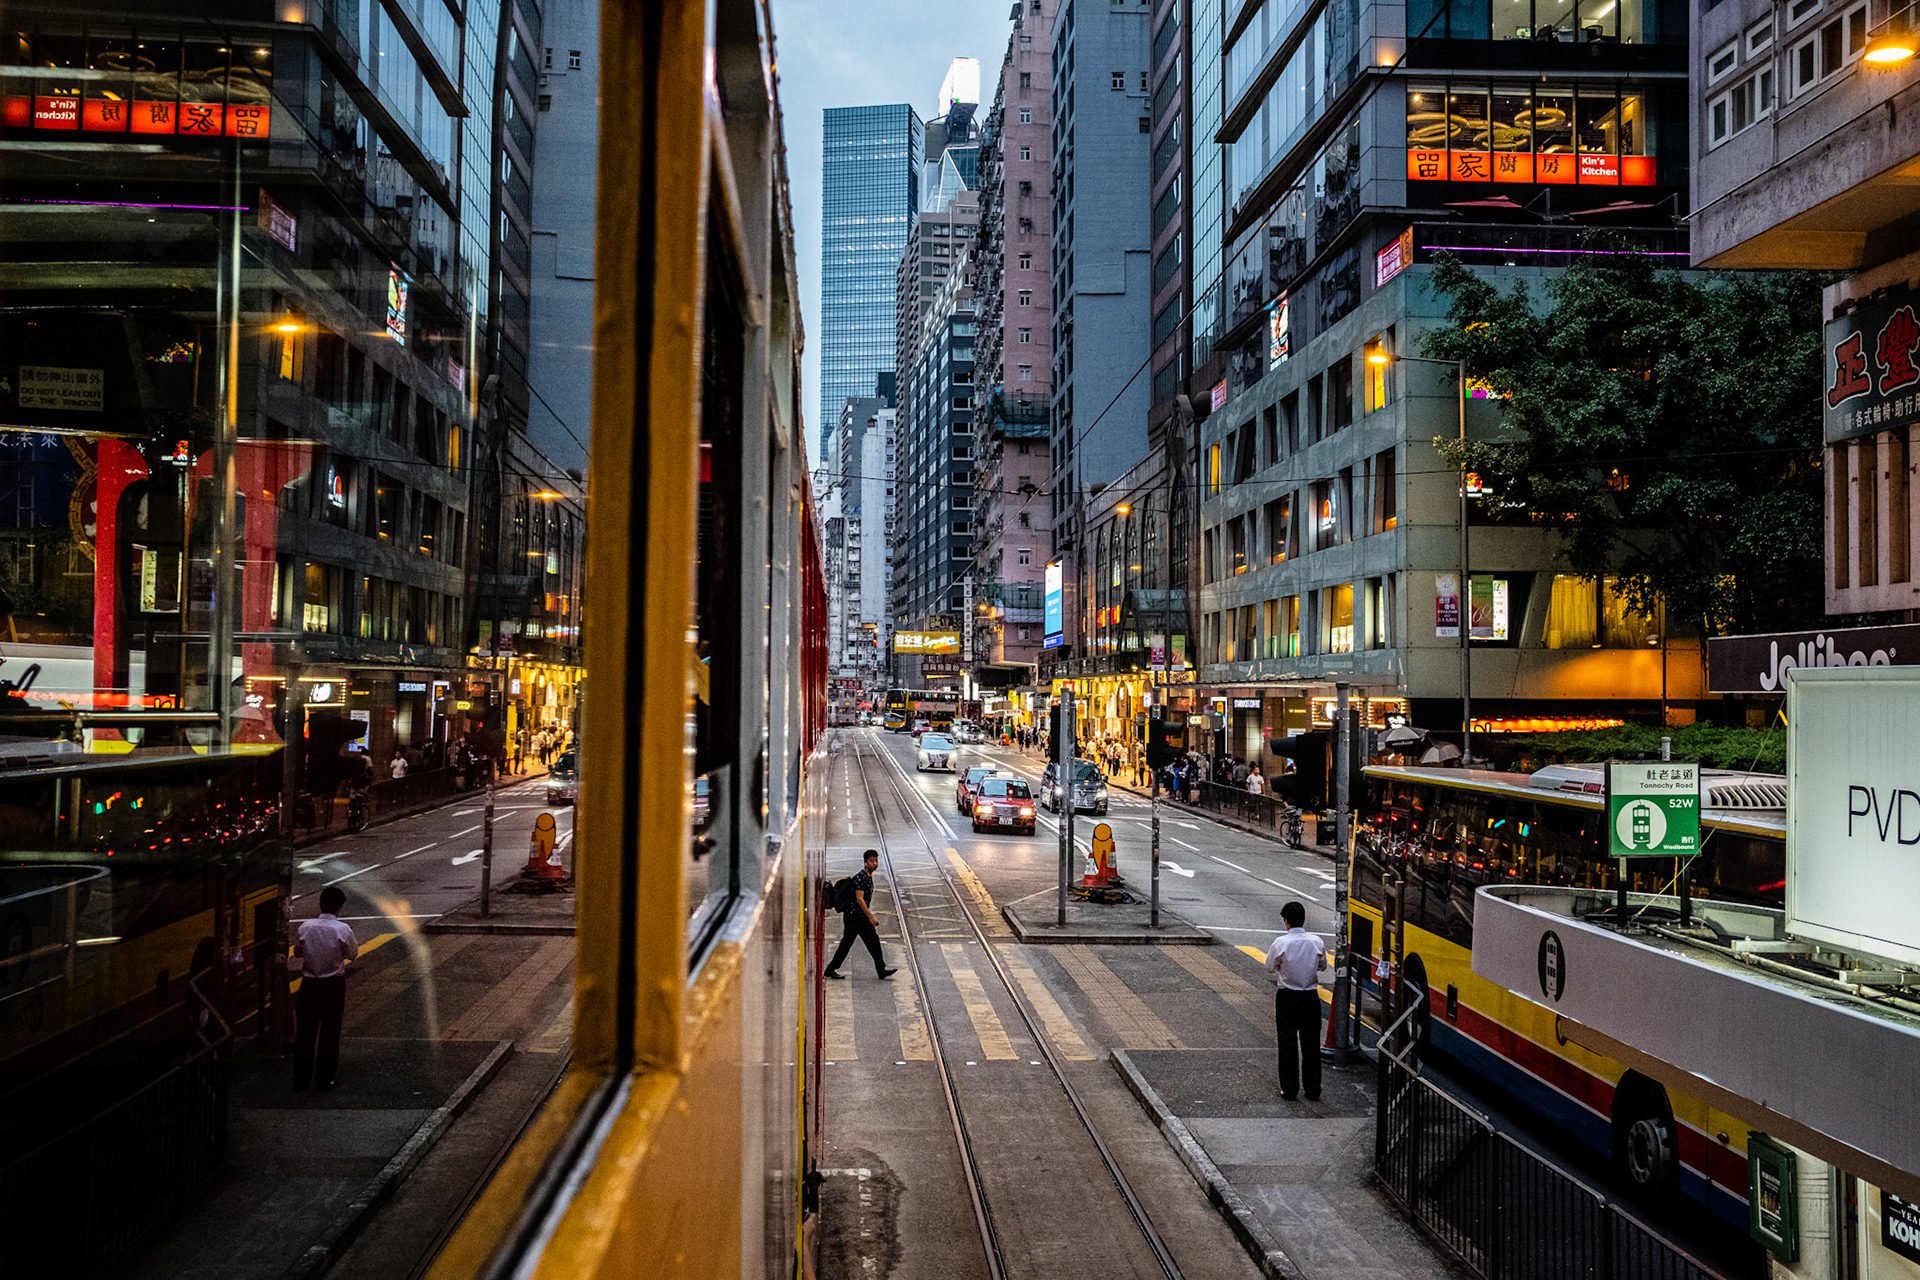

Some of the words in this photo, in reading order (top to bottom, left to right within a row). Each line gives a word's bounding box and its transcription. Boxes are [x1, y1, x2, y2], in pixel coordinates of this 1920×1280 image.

[1581, 156, 1605, 166] Kin's
[1581, 166, 1618, 176] Kitchen
[21, 387, 35, 395] DO
[36, 388, 56, 396] NOT
[57, 389, 80, 398] LEAN
[82, 390, 101, 398] OUT
[21, 396, 33, 404] OF
[40, 397, 57, 405] THE
[62, 399, 101, 408] WINDOW
[1646, 769, 1693, 780] 杜老誌道
[1668, 798, 1694, 808] 52W
[1901, 1209, 1920, 1228] YEA
[1889, 1216, 1920, 1250] KOH
